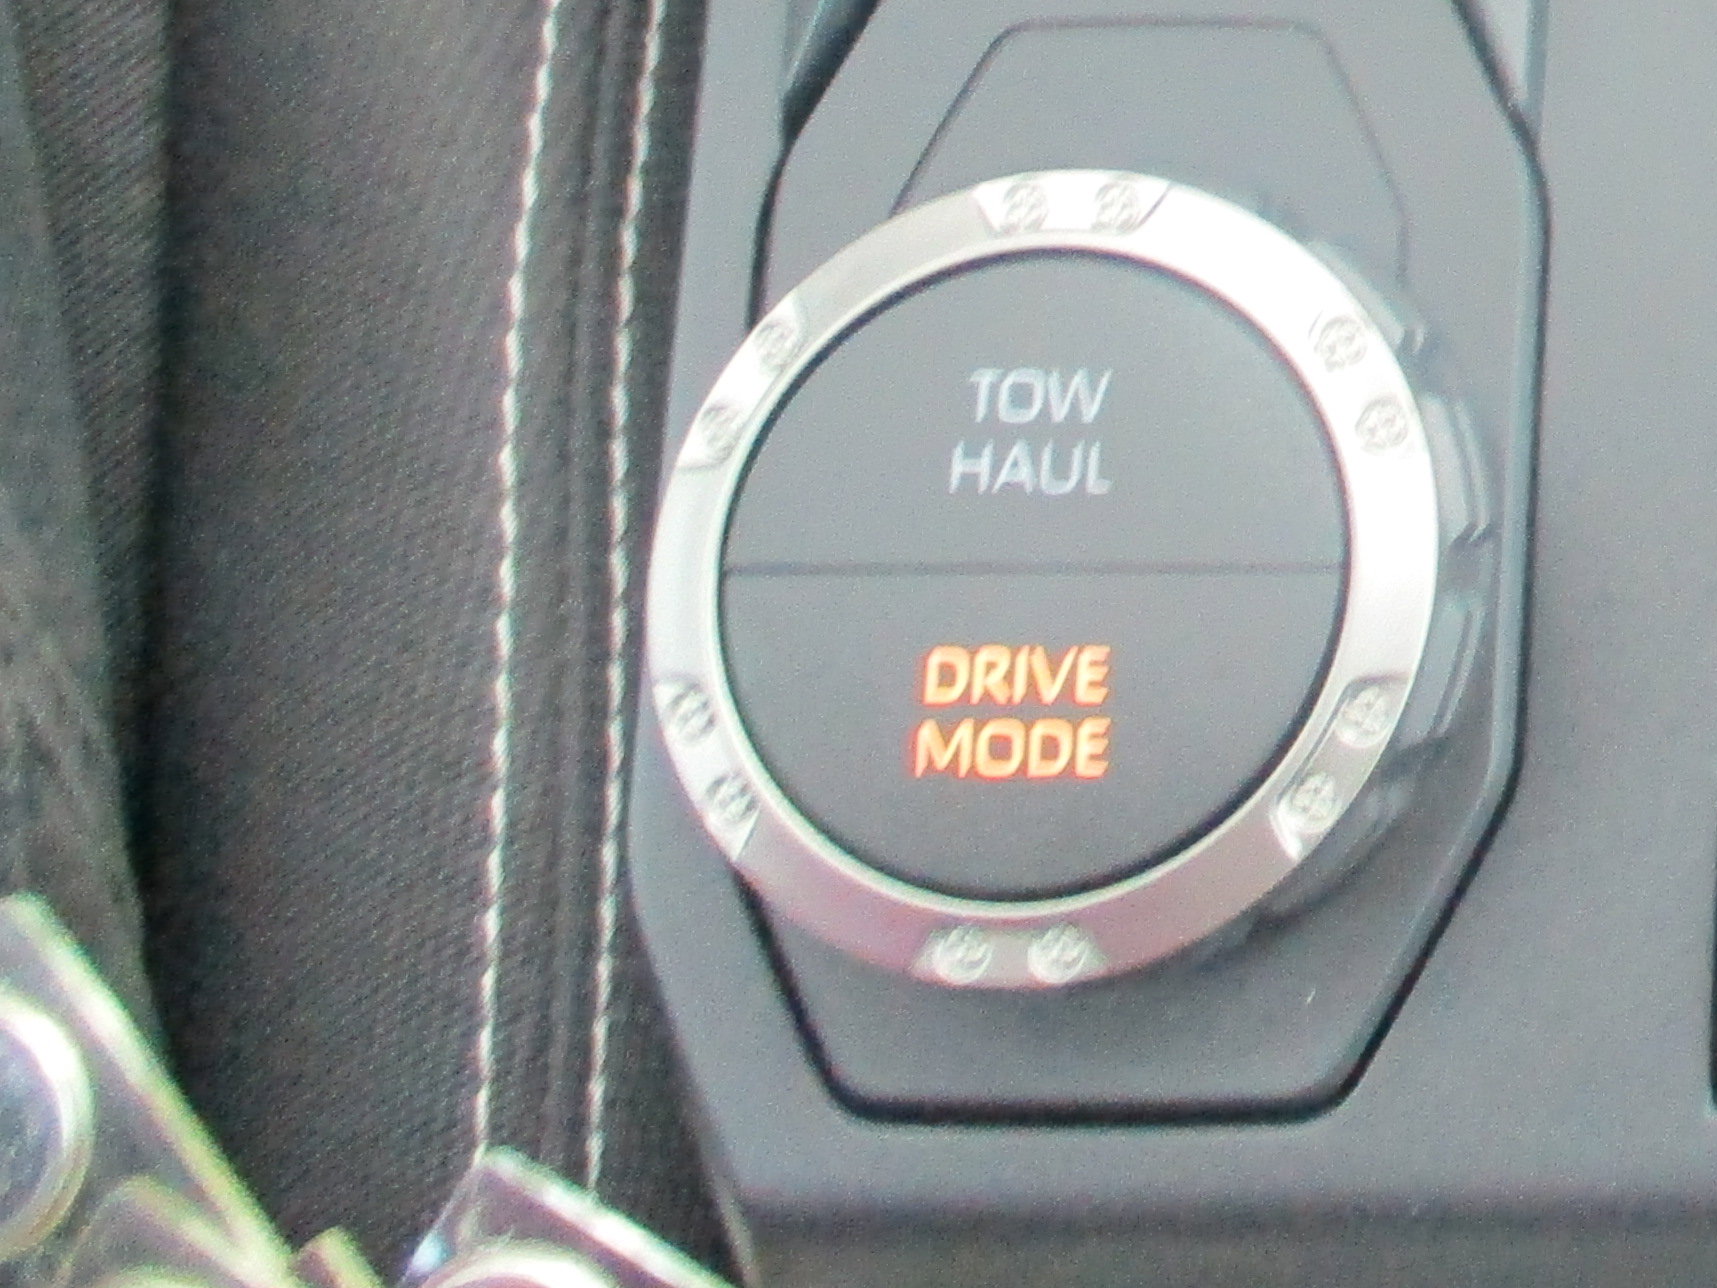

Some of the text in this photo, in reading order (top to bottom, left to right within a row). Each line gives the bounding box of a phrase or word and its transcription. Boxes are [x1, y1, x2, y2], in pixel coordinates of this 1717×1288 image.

[970, 367, 1112, 424] TOW
[948, 438, 1113, 496] HAUL
[920, 643, 1112, 708] DRIVE
[910, 716, 1112, 780] MODE
